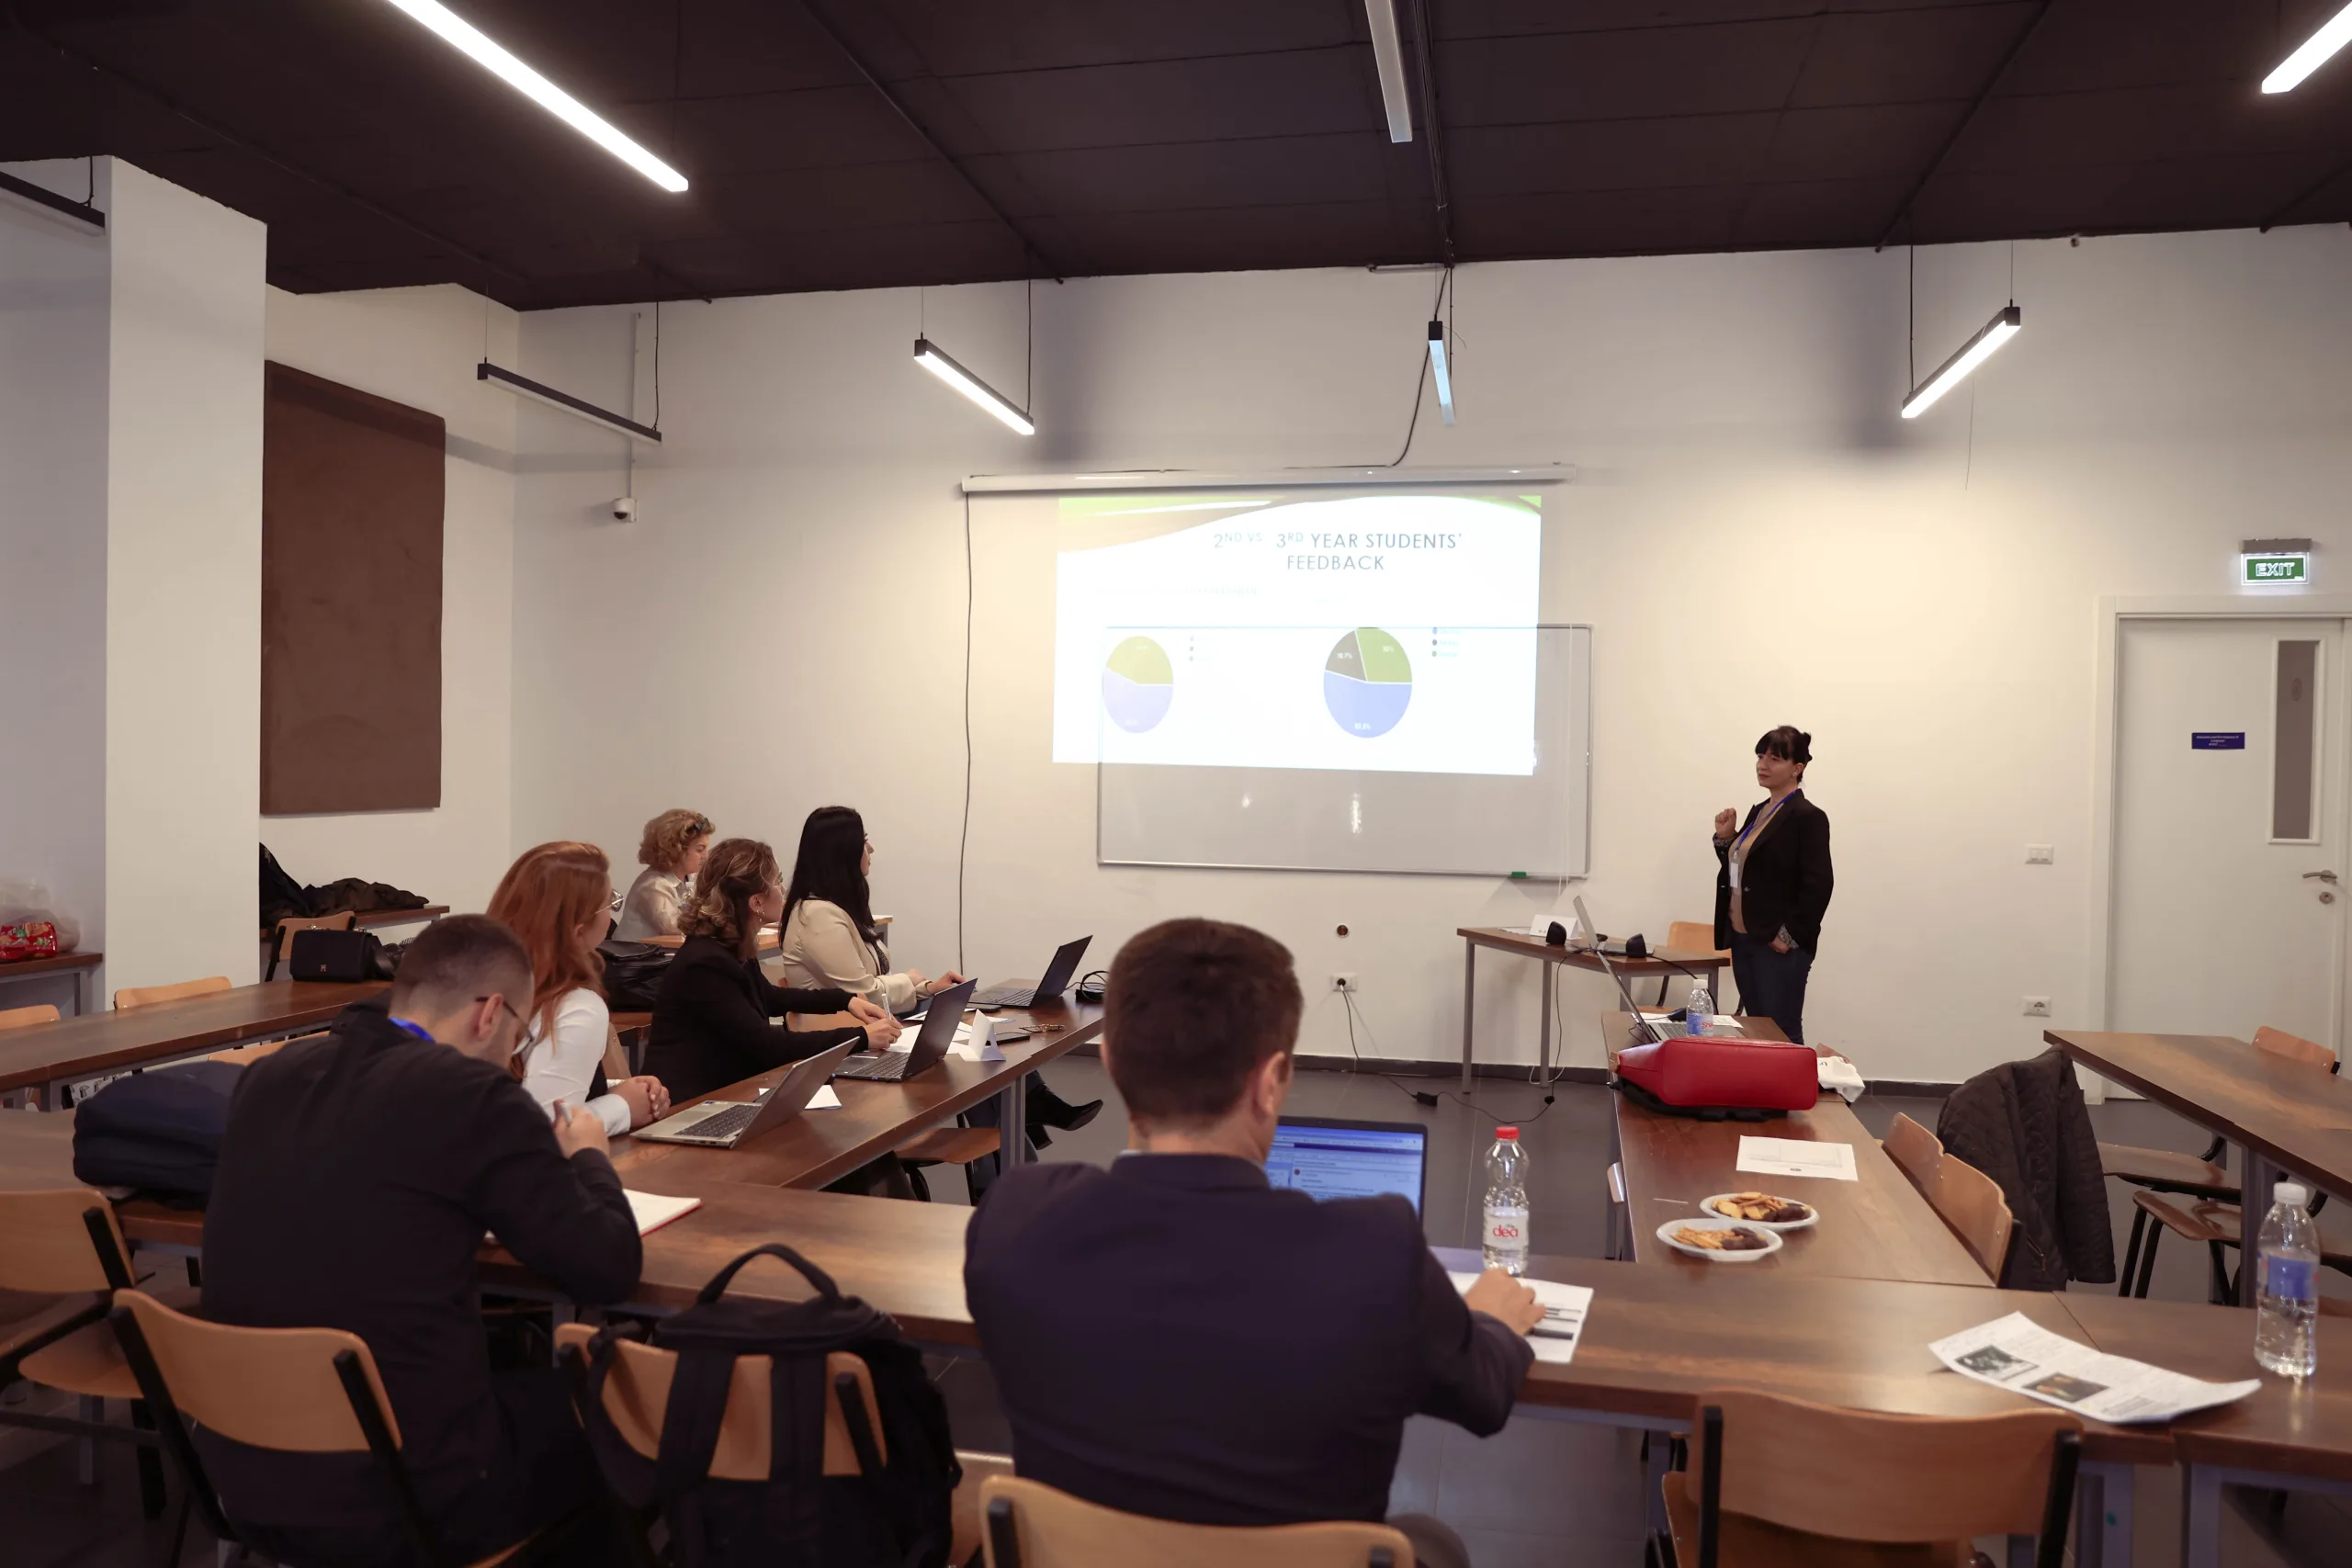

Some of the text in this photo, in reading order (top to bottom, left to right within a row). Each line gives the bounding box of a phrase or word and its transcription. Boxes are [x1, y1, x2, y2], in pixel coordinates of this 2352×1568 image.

[1276, 532, 1304, 549] 3RD
[1310, 533, 1359, 549] YEAR
[1286, 555, 1385, 570] FEEDBACK
[2255, 561, 2296, 577] EXIT
